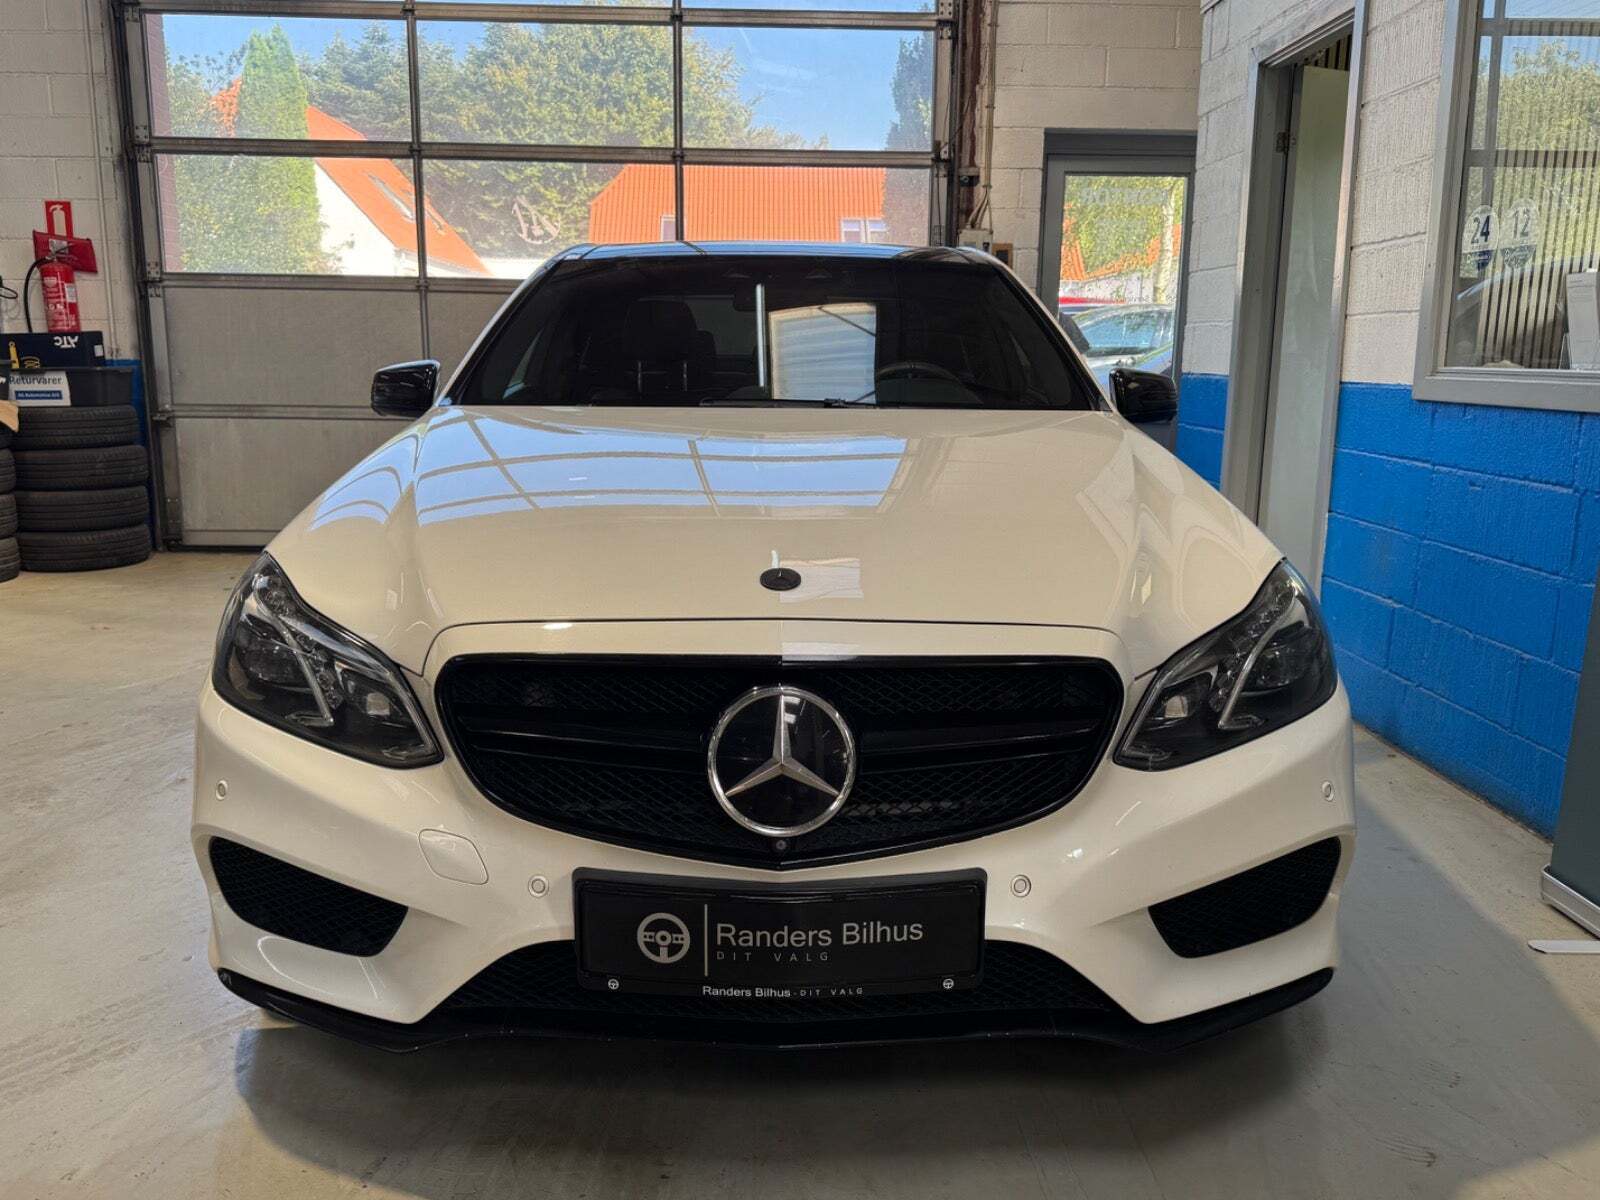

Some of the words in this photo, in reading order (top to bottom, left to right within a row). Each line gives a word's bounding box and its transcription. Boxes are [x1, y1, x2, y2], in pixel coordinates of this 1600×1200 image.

[1471, 215, 1491, 244] 24
[716, 923, 832, 947] Randers
[842, 921, 924, 945] Bilhus
[716, 951, 752, 962] DIT
[774, 952, 829, 963] VALG
[702, 985, 752, 997] Randers
[755, 986, 791, 998] Bilhus
[800, 988, 820, 997] DIT
[831, 988, 863, 996] VALG
